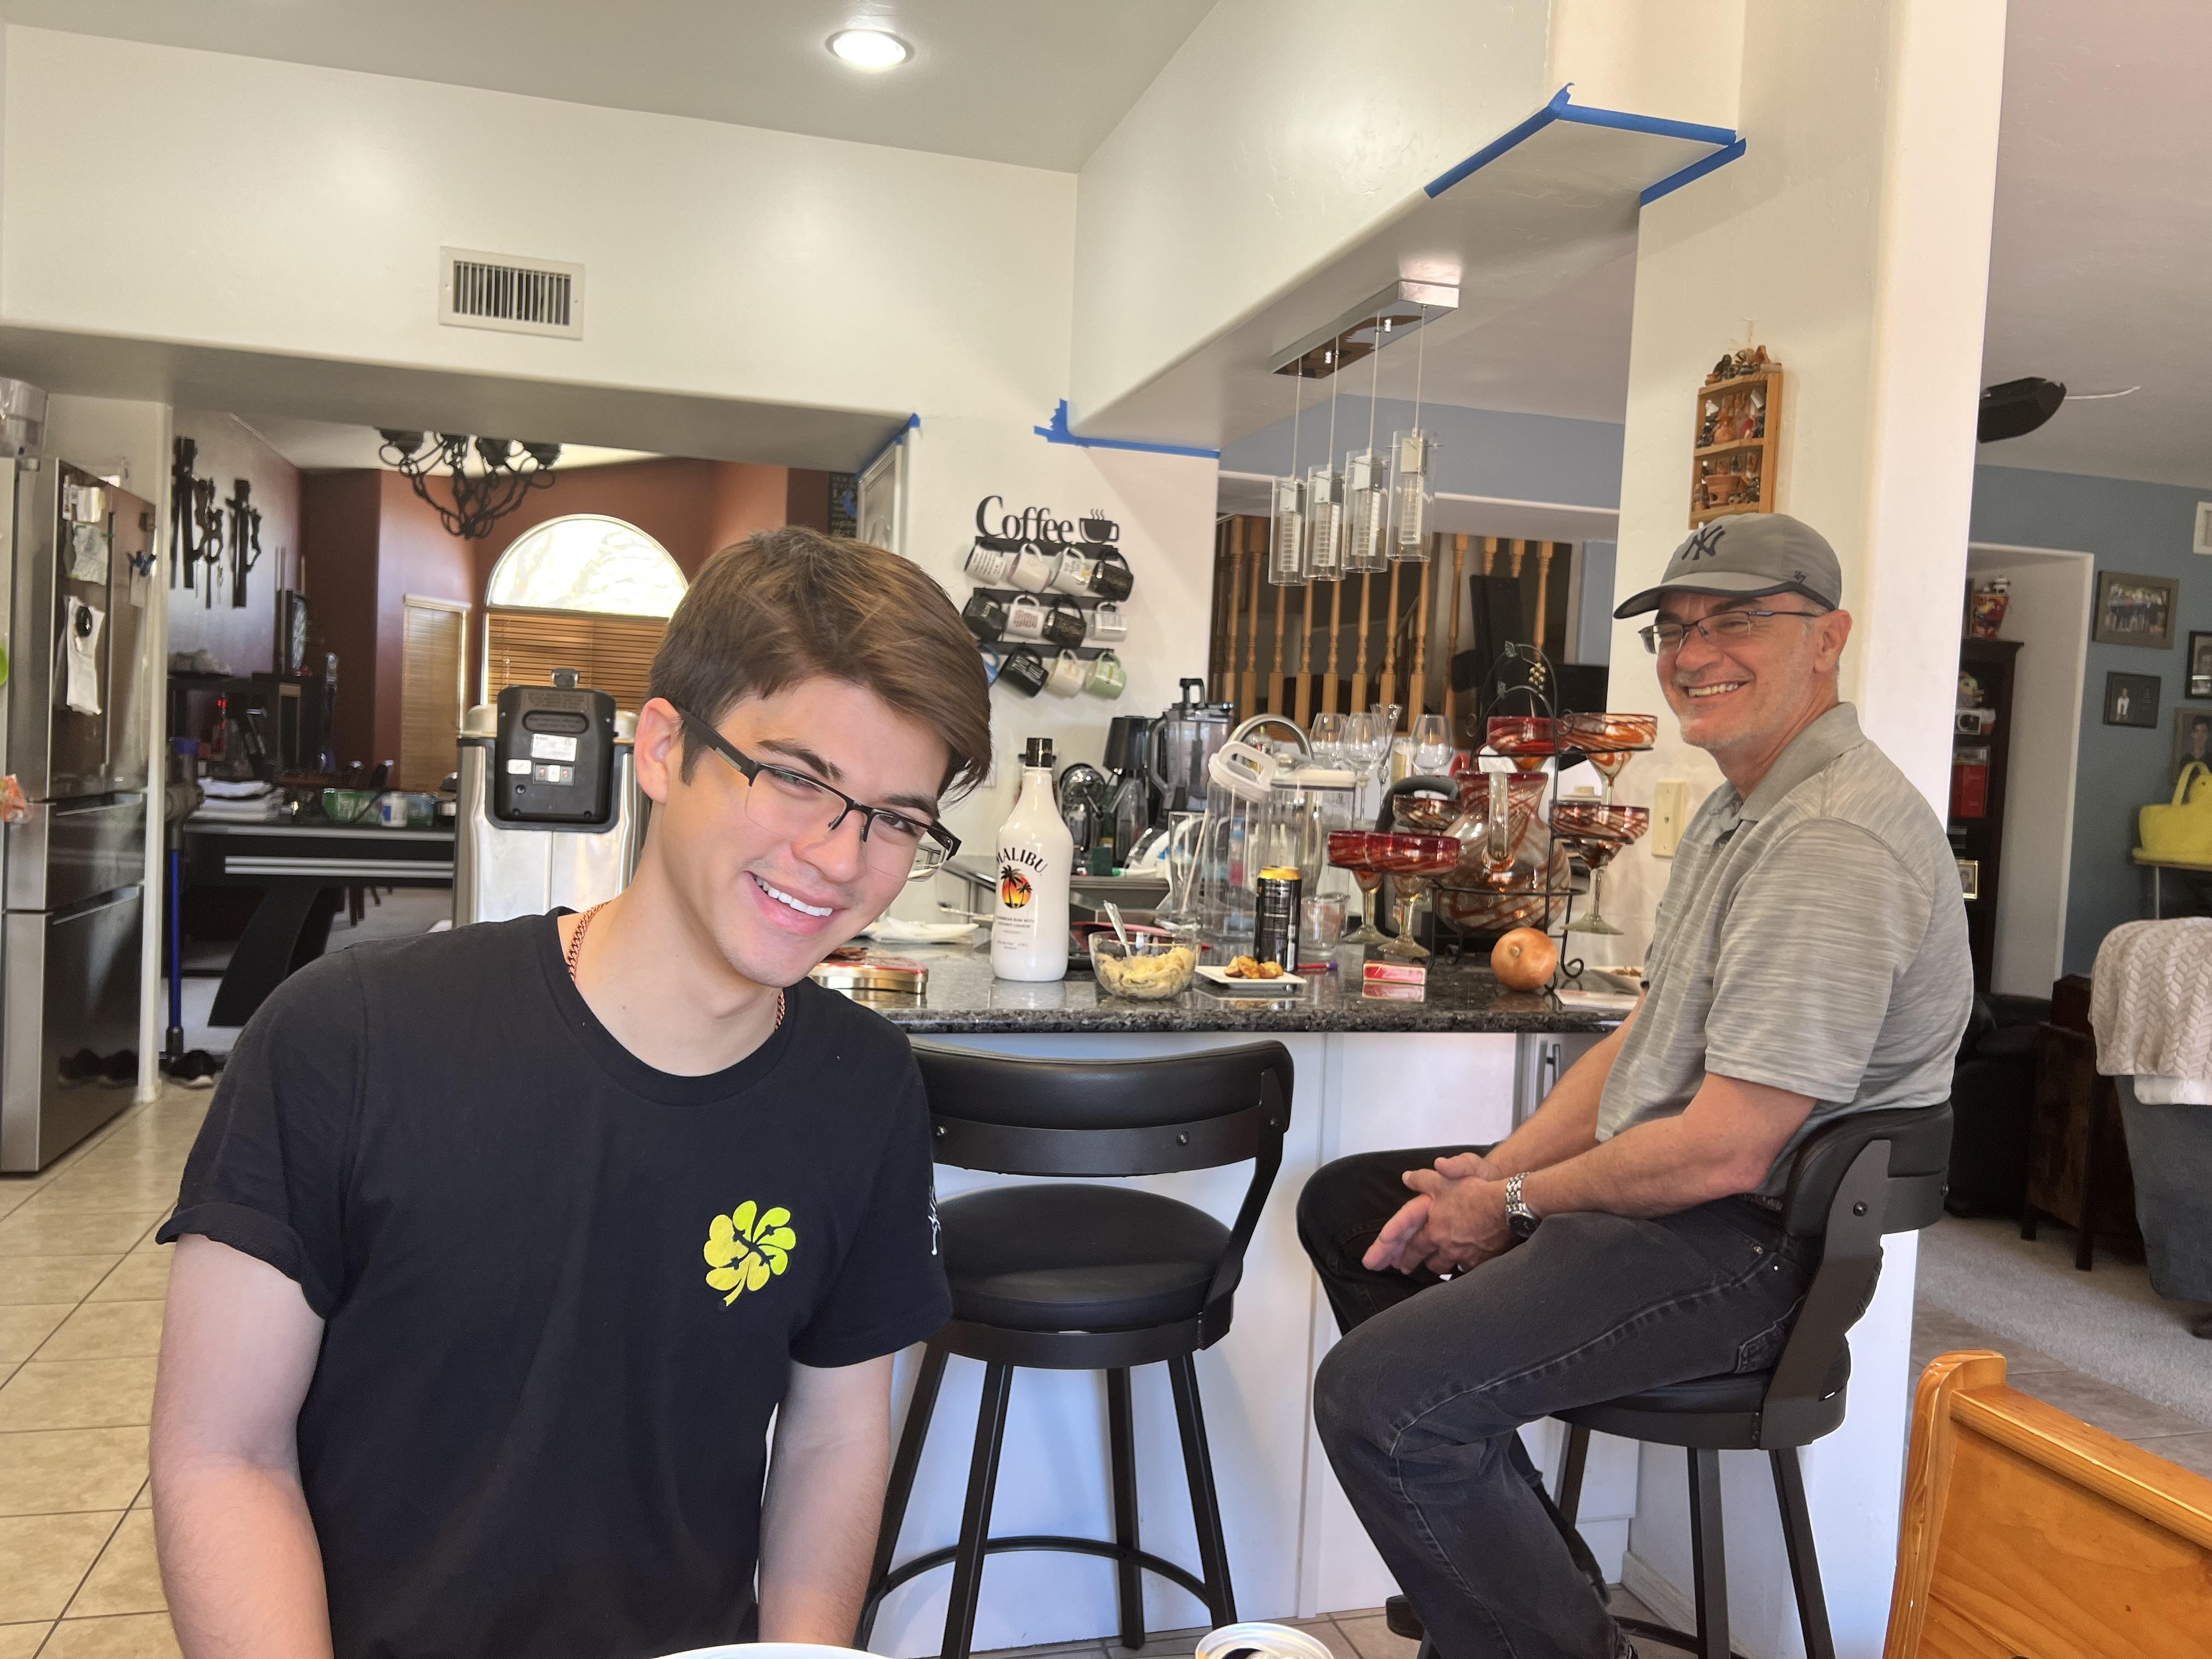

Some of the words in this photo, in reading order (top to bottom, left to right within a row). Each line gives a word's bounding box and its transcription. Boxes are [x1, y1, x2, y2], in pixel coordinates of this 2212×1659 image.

[976, 495, 1074, 543] Coffee
[1681, 525, 1725, 560] NY
[996, 848, 1048, 873] MALIBU
